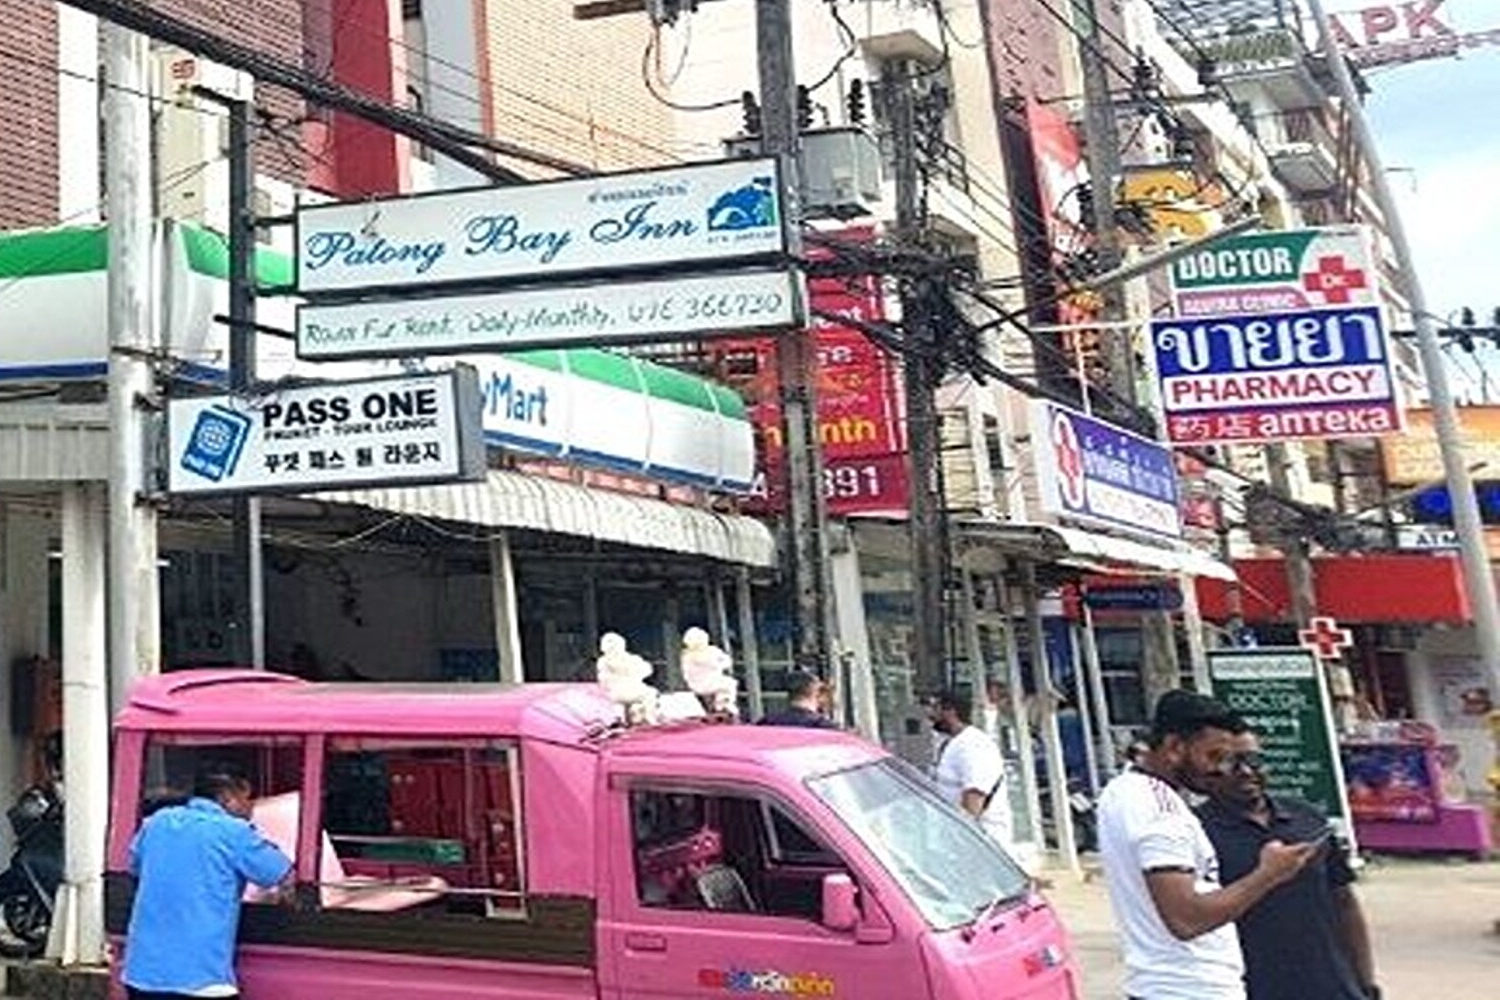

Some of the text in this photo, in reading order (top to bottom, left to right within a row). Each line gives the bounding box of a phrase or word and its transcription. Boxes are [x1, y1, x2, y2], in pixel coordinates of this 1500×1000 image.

[305, 201, 699, 274] Patong Bay Inn
[1179, 246, 1294, 280] DOCTOR
[1157, 313, 1383, 373] ขายยา
[1171, 367, 1378, 405] PHARMACY
[263, 388, 438, 429] PASS ONE
[1257, 406, 1391, 436] аптека
[383, 441, 442, 465] 라운지
